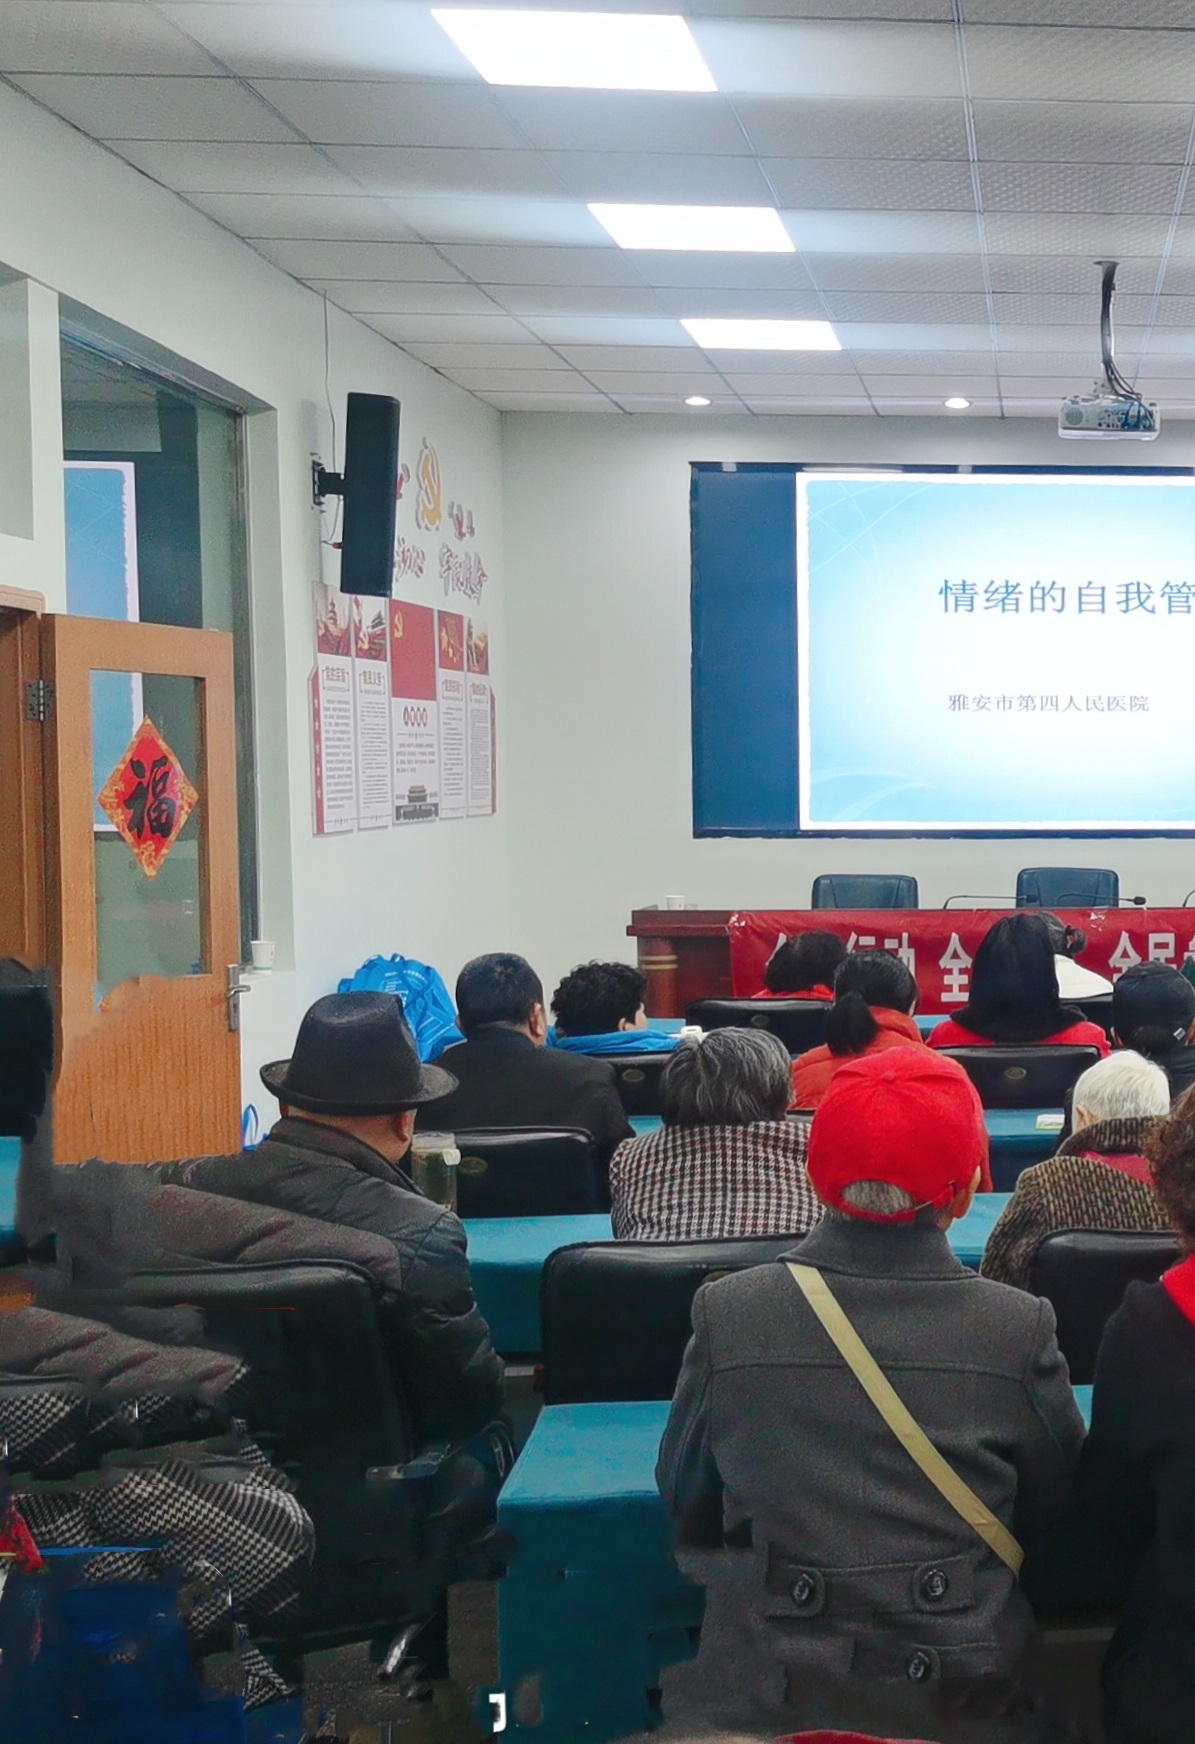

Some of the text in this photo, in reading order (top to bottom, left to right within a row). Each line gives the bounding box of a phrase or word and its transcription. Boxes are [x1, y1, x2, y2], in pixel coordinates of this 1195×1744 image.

[947, 693, 1150, 713] 雅安市第四人民医院
[123, 755, 177, 840] 福
